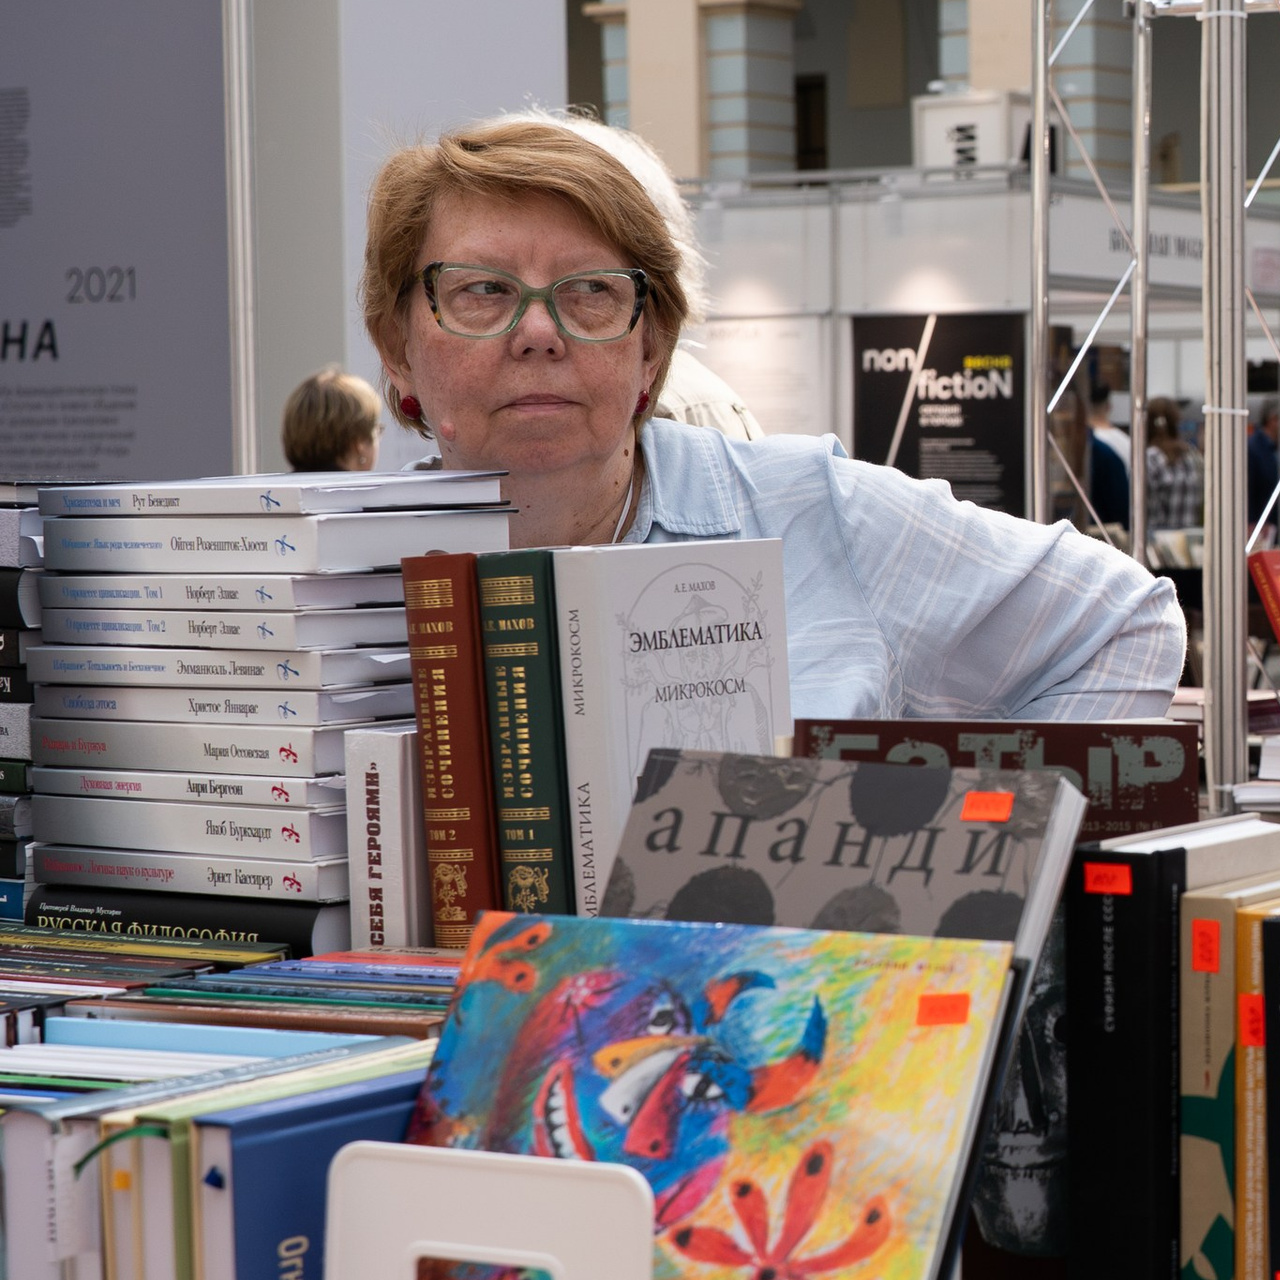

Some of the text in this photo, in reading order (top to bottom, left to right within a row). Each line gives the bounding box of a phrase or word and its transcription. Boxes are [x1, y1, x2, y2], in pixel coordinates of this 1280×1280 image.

[65, 265, 137, 304] 2021
[0, 318, 59, 362] НА
[132, 493, 146, 510] Рут
[147, 493, 181, 509] Бенедикт
[170, 535, 195, 552] Ойген
[196, 535, 268, 552] Розеншток-Хюсси
[143, 586, 157, 600] Том
[185, 585, 216, 604] Норберт
[217, 586, 240, 600] Элиас
[146, 620, 160, 633] Том
[188, 619, 217, 635] Норберт
[219, 620, 241, 634] Элиас
[419, 621, 454, 634] МАХОВ
[498, 618, 536, 631] МАХОВ
[629, 621, 763, 654] ЭМБЛЕМАТИКА
[176, 659, 228, 676] Эмманюэль
[228, 660, 265, 677] Левинас
[568, 608, 586, 717] МИКРОКОСМ
[654, 678, 747, 703] МИКРОКОСМ
[188, 697, 221, 714] Христос
[223, 698, 259, 715] Яннарас
[417, 667, 436, 800] ИЗБРАННЫЕ
[432, 667, 455, 800] СОЧИНЕНИЯ
[495, 665, 514, 799] ИЗБРАННЫЕ
[512, 665, 534, 799] СОЧИНЕНИЯ
[203, 742, 230, 760] Мария
[230, 744, 270, 760] Оссовская
[186, 778, 208, 795] Анри
[208, 779, 243, 798] Бергсон
[205, 819, 272, 842] Якоб Буркхардт
[365, 761, 384, 881] ГЕРОЯМИ»
[1081, 821, 1131, 833] 013-2015
[429, 829, 457, 841] ТОМ 2
[505, 829, 535, 841] ТОМ 1
[577, 782, 598, 919] МБЛЕМАТИКА
[207, 867, 232, 886] Эрнст
[234, 868, 273, 890] Кассирер
[367, 888, 385, 948] СЕБЯ
[1102, 892, 1114, 923] ССС
